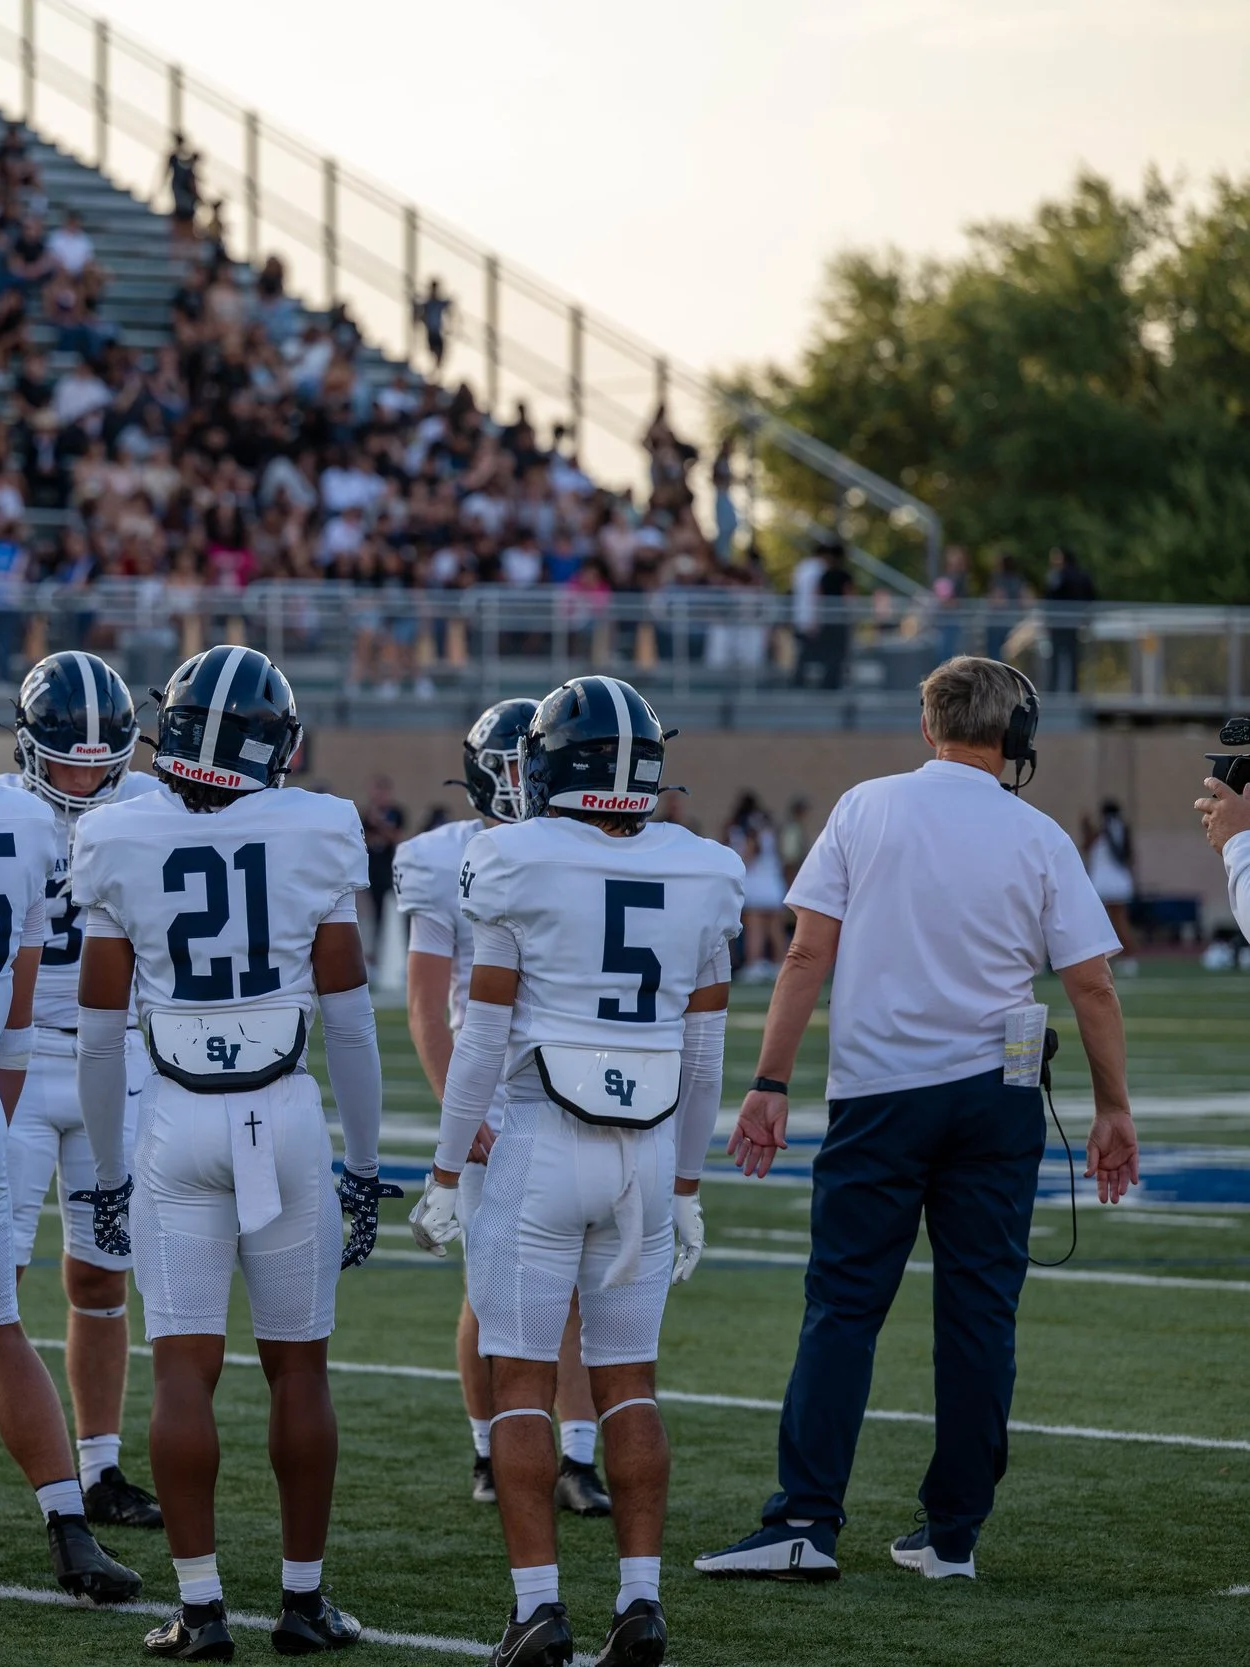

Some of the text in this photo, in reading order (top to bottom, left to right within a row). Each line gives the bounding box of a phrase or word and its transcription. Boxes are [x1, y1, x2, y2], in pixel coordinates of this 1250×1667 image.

[76, 745, 107, 755] Riddell
[172, 760, 241, 788] Riddell
[581, 794, 649, 810] Riddell
[460, 861, 476, 898] SV
[162, 842, 282, 1000] 21
[598, 879, 665, 1023] 5
[207, 1036, 241, 1070] SV
[605, 1069, 636, 1107] SV
